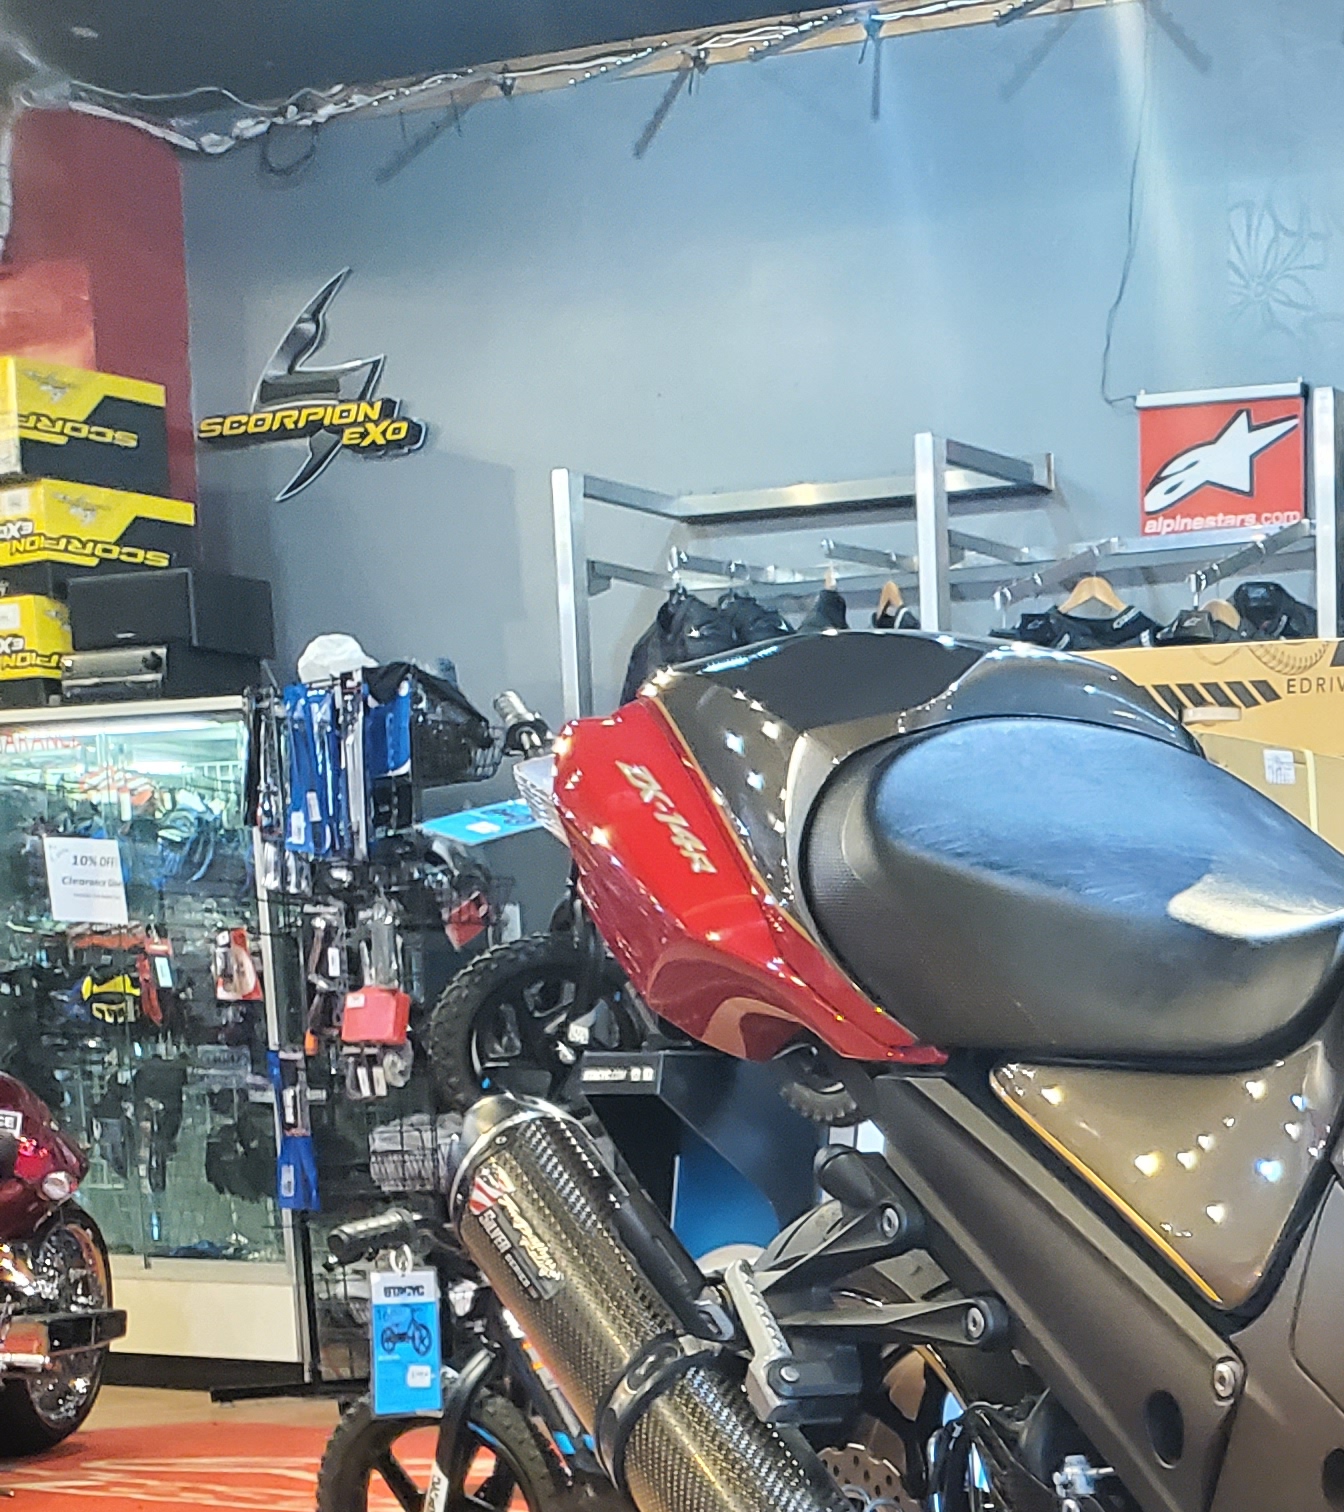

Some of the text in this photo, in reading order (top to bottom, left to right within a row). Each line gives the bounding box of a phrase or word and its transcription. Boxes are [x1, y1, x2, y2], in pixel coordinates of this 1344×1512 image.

[198, 401, 382, 439] SCORPION
[342, 419, 409, 447] EXO
[1145, 510, 1300, 534] alpinestars.com
[11, 534, 170, 567] SCORPION
[615, 760, 719, 873] ZX-14R
[478, 1208, 513, 1254] SILVER
